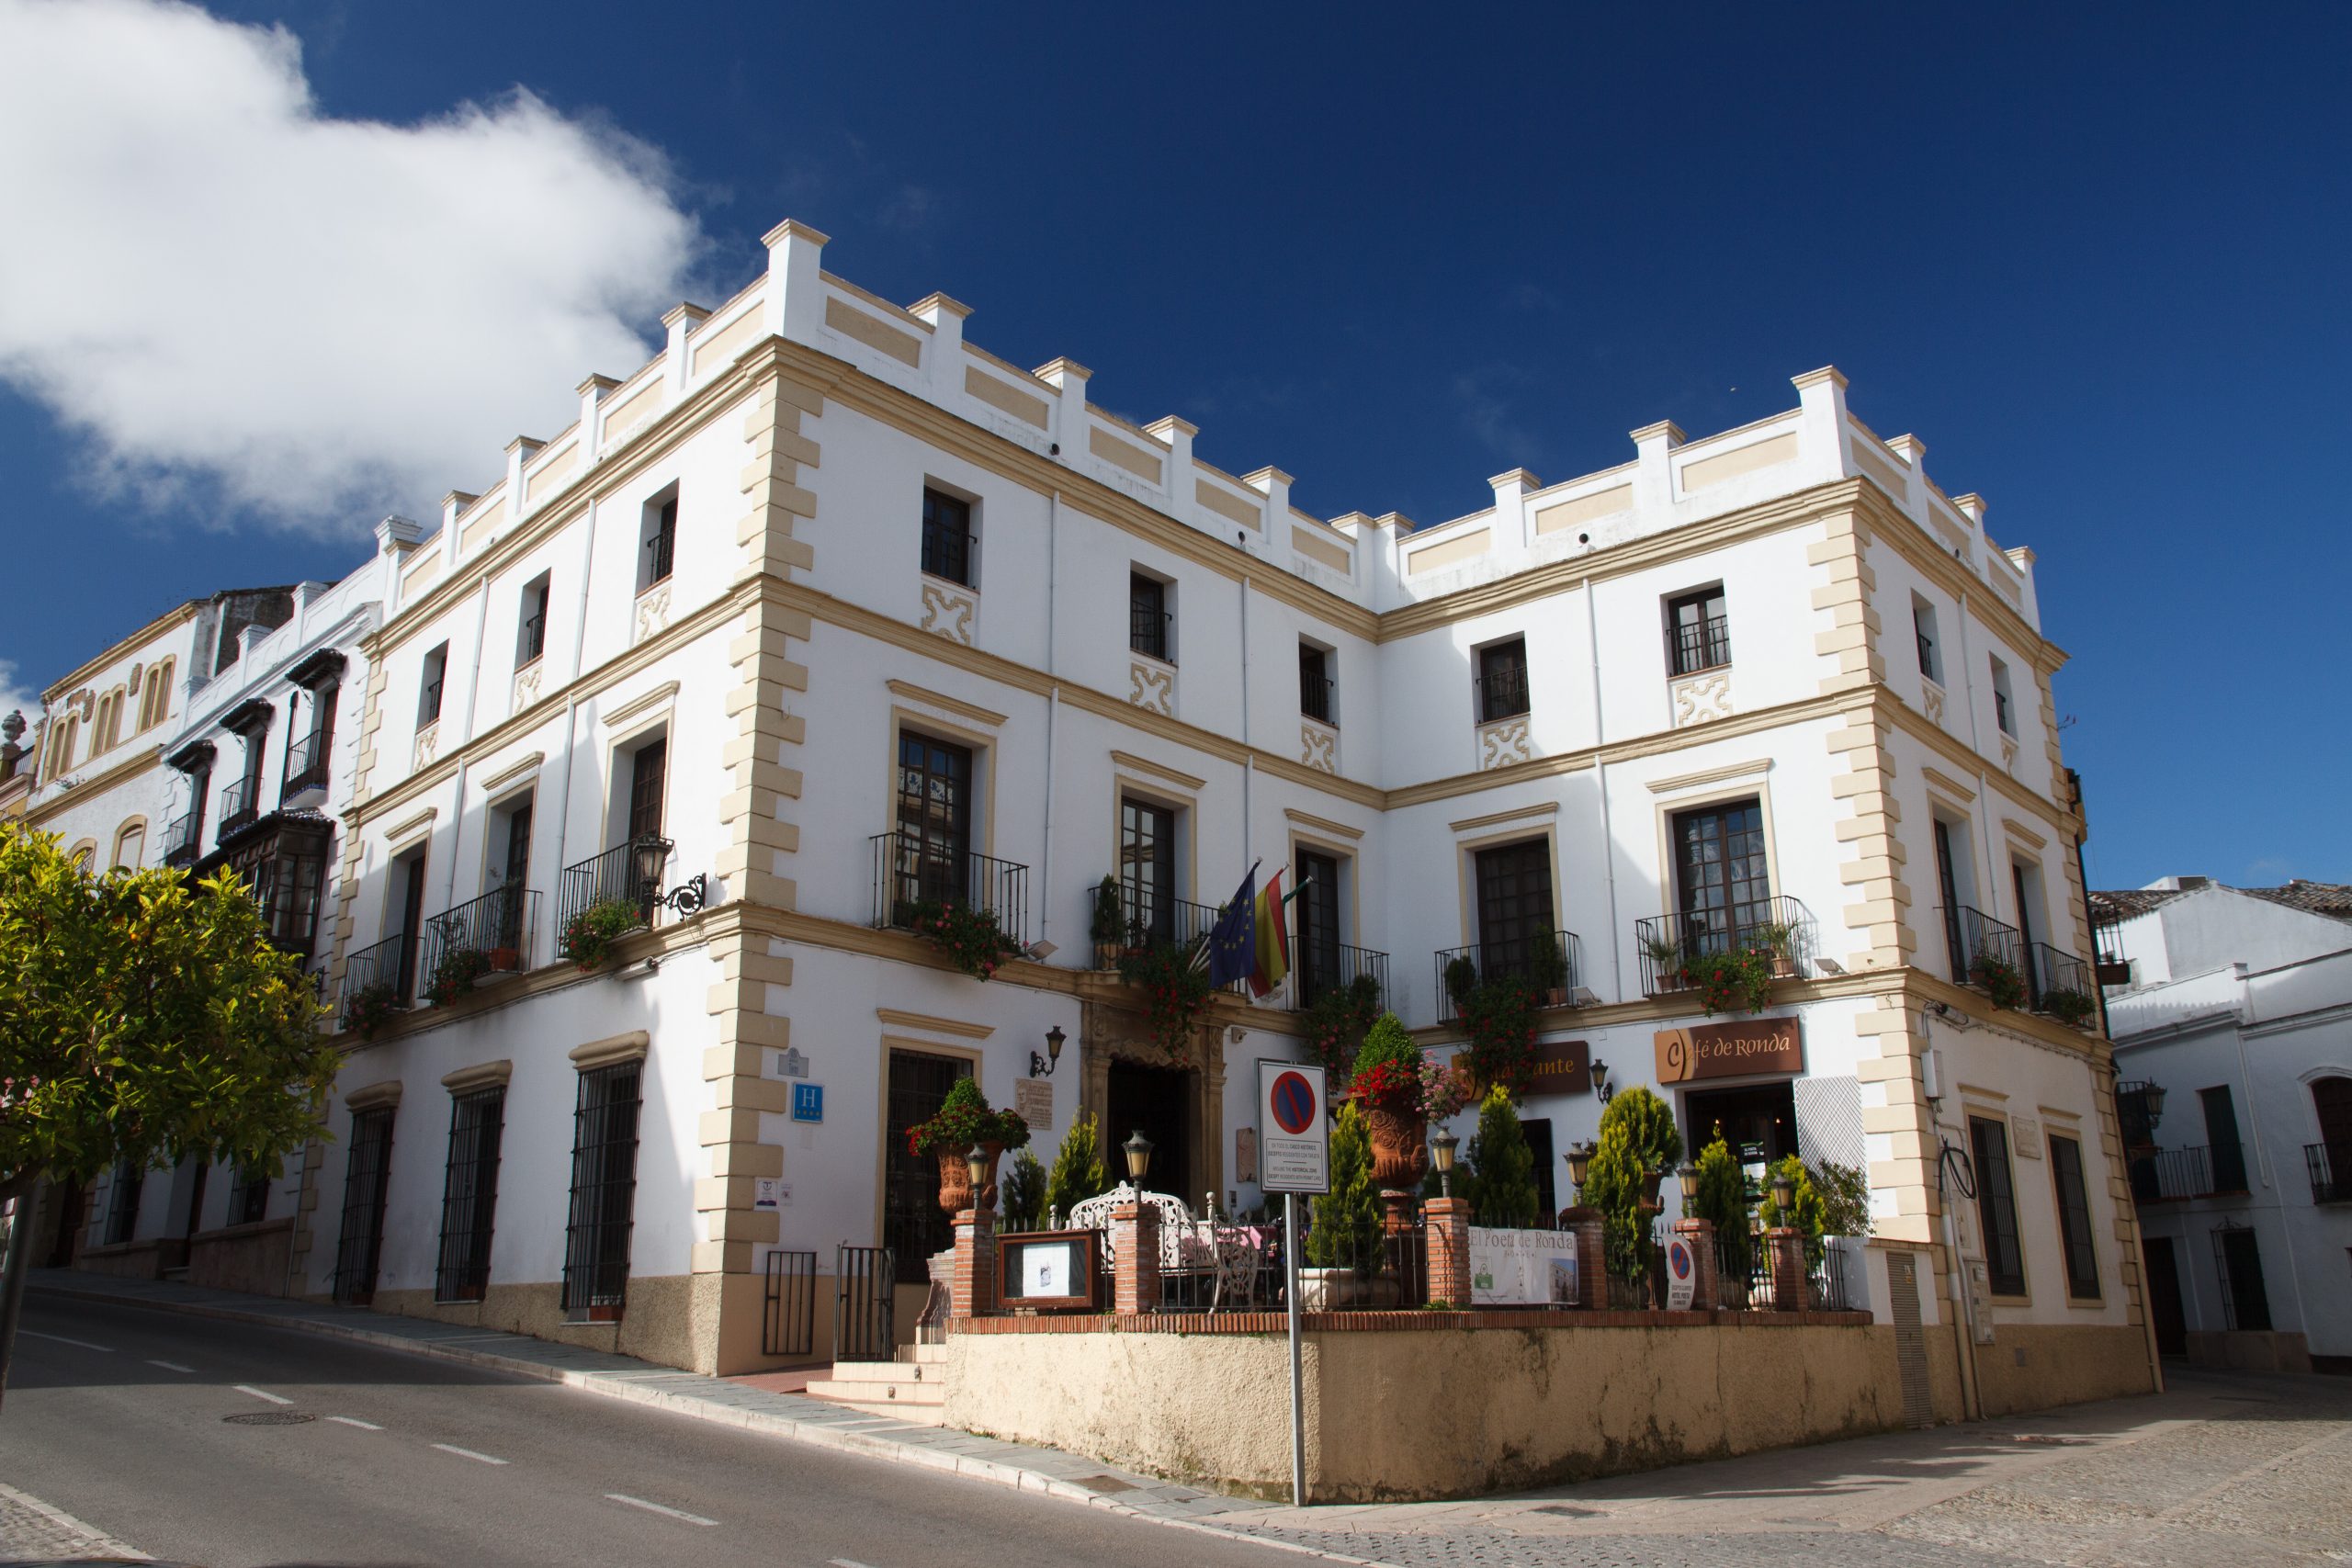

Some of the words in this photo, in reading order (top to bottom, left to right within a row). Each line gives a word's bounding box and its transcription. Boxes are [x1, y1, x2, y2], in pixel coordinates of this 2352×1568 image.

[1667, 1039, 1710, 1068] Café
[1713, 1037, 1732, 1057] de
[1735, 1033, 1791, 1057] Ronda
[801, 1088, 817, 1108] H
[1470, 1230, 1481, 1246] El
[1485, 1230, 1515, 1248] Poeta
[1519, 1231, 1531, 1248] de
[1535, 1231, 1574, 1250] Ronda
